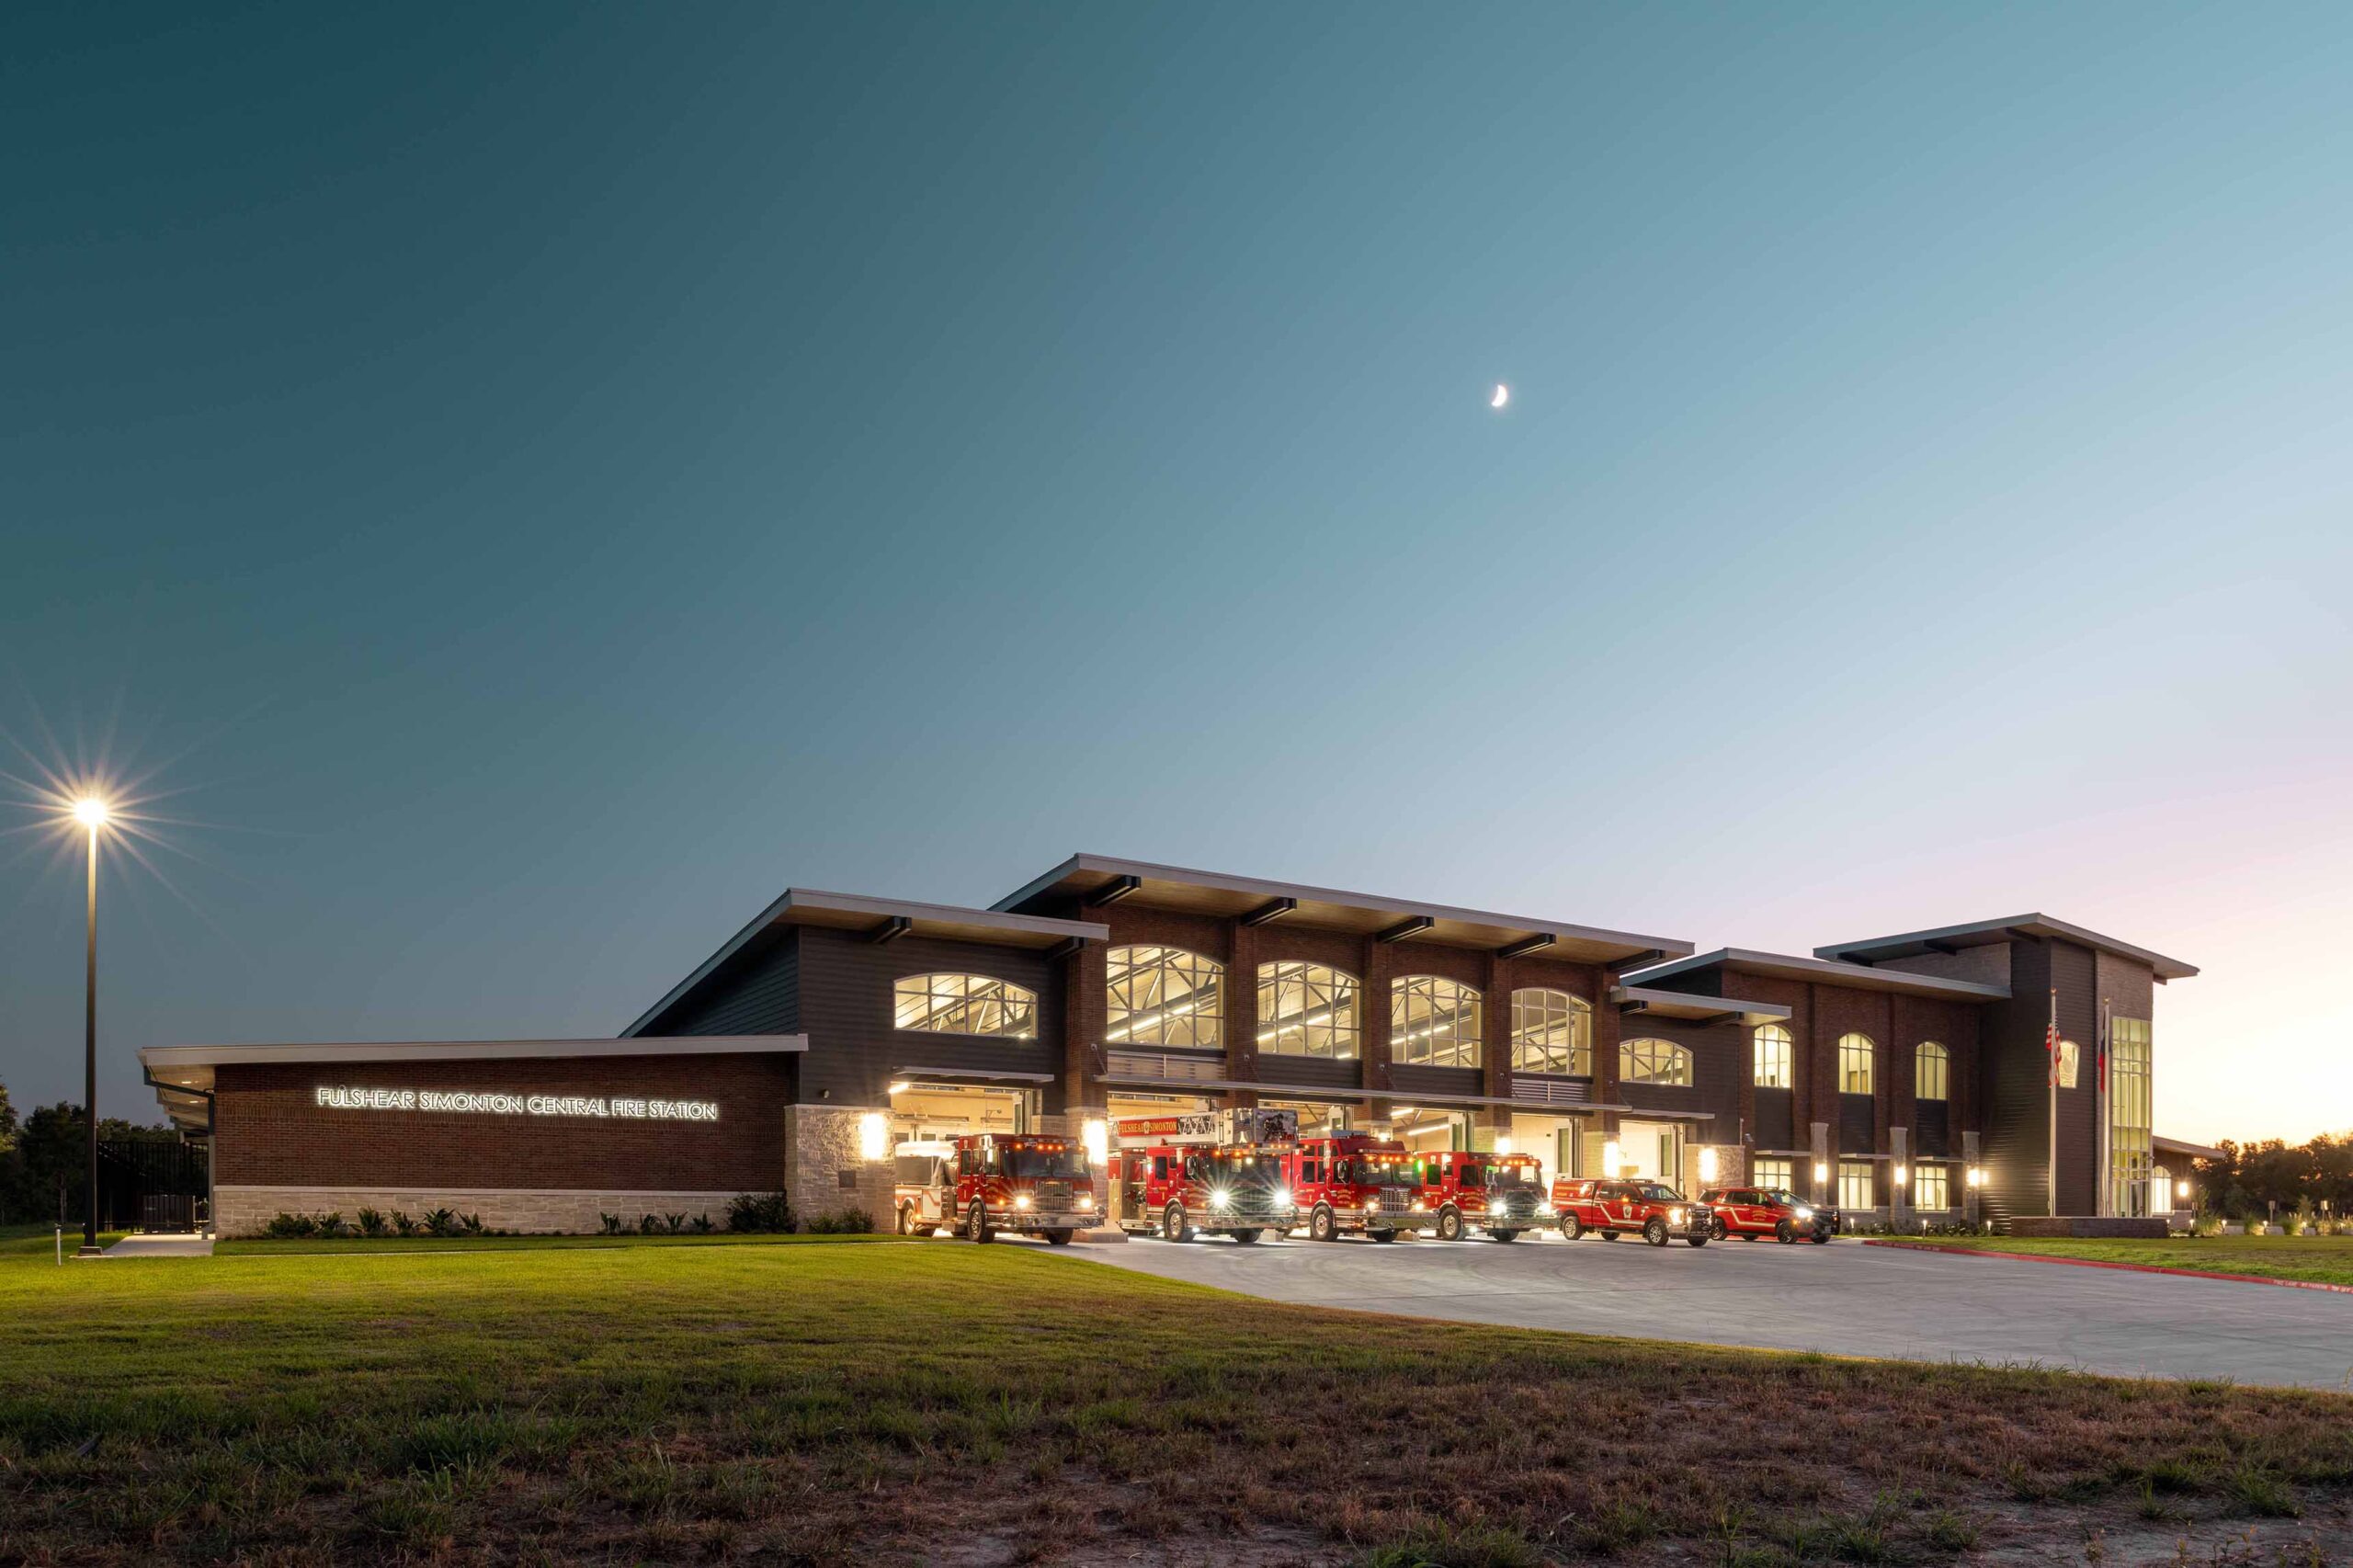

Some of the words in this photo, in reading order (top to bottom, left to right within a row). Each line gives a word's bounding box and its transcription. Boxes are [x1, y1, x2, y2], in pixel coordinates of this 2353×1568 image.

[318, 1088, 415, 1108] FULSHEAR
[419, 1092, 524, 1111] SIMONTON
[529, 1096, 609, 1116] CENTRAL
[612, 1100, 645, 1117] FIRE
[648, 1102, 718, 1119] STATION
